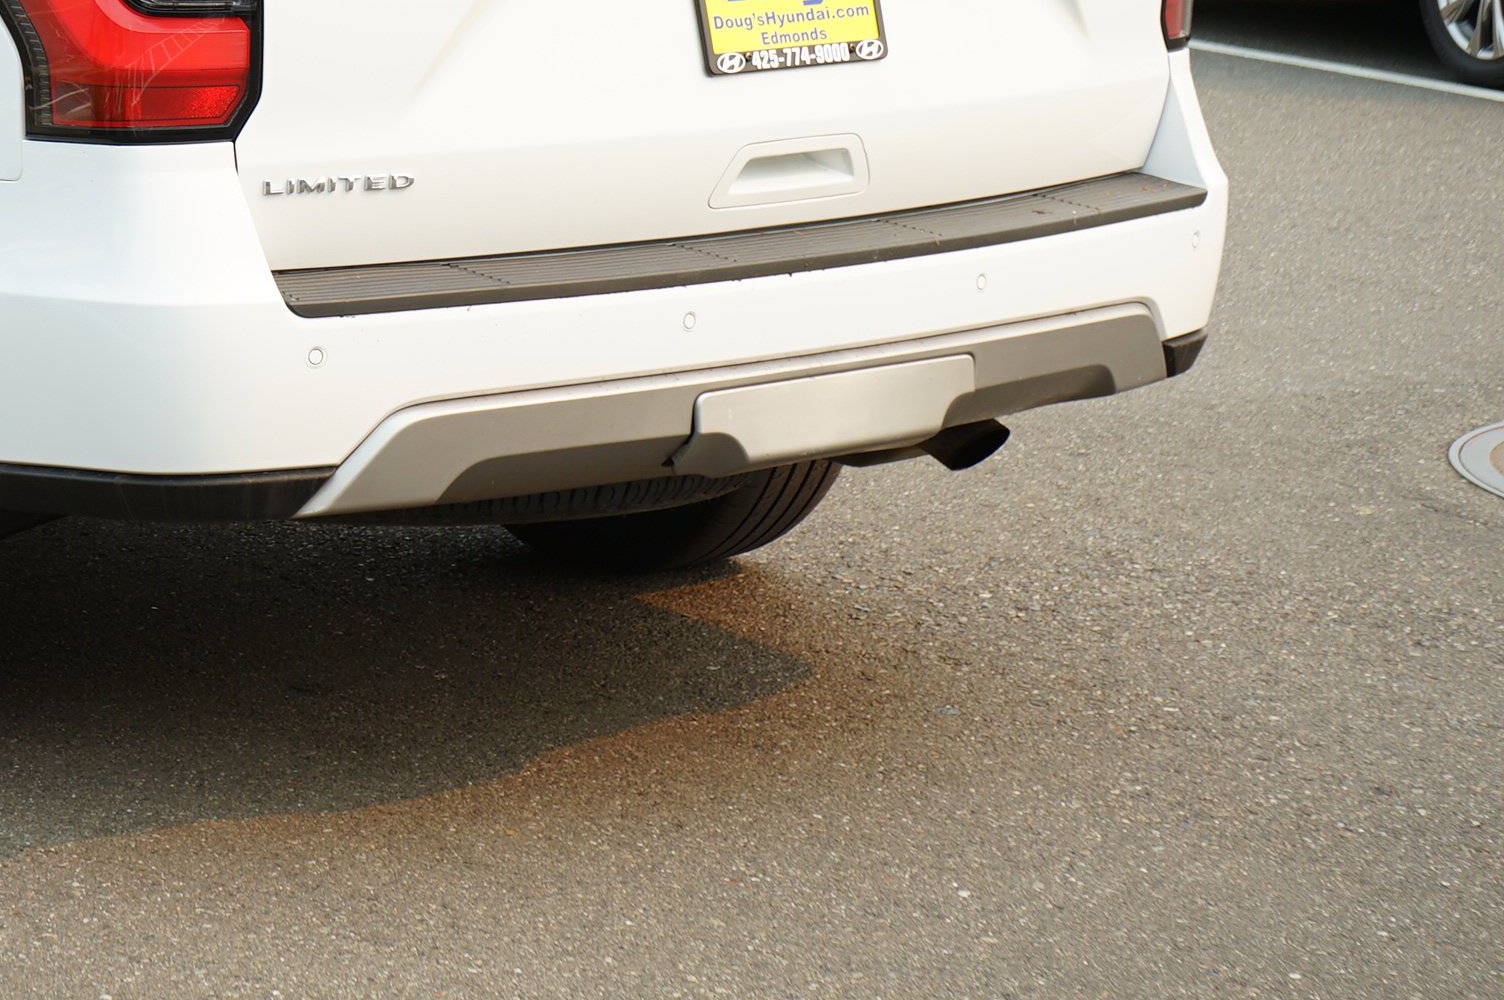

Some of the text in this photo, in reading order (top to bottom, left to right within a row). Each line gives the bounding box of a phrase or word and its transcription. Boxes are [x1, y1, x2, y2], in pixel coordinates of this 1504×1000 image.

[713, 5, 869, 30] Doug'sHyundai.com
[761, 28, 828, 45] Edmonds
[752, 42, 851, 70] 425-774-9000
[262, 174, 415, 196] LIMITED
